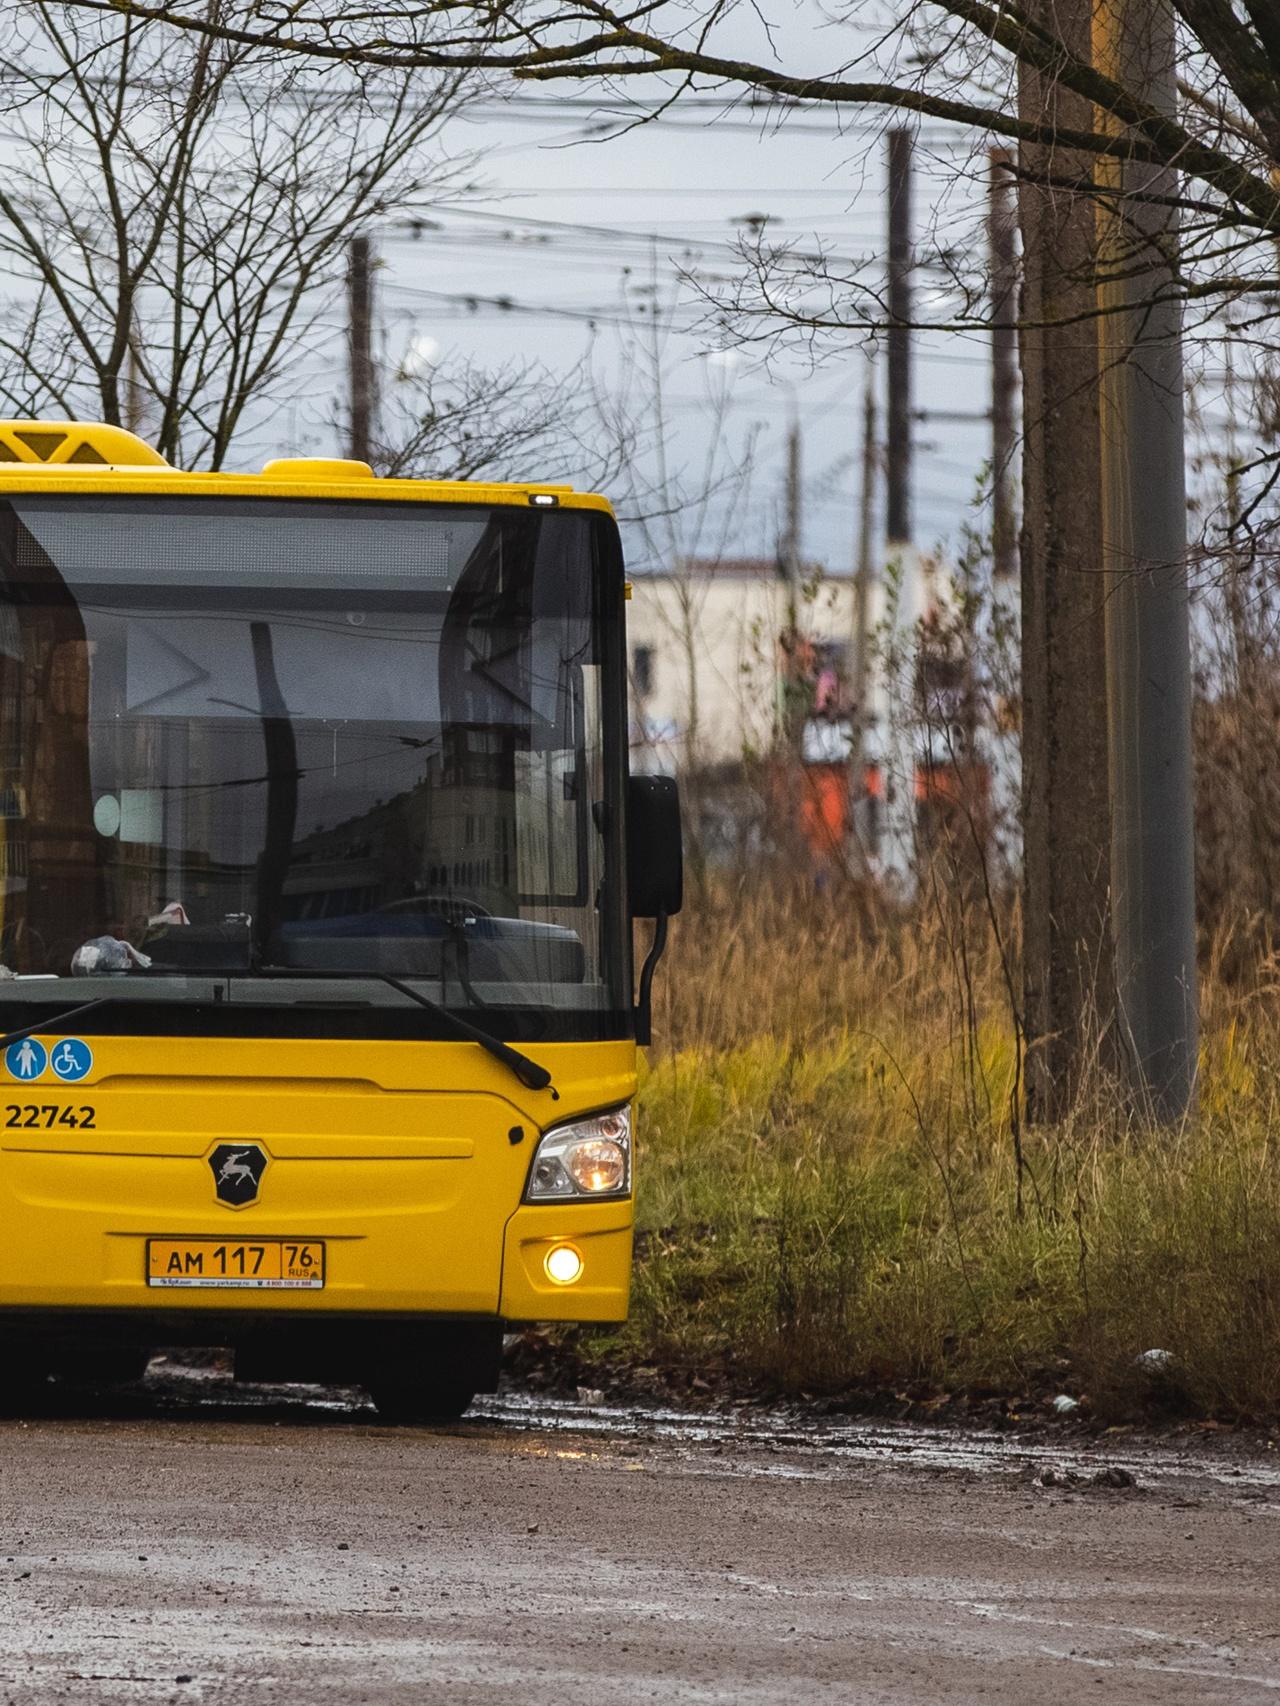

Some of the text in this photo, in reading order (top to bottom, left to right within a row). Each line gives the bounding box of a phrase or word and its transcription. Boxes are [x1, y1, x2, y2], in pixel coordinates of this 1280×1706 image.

[5, 1104, 96, 1129] 22742
[213, 1246, 265, 1275] 117
[285, 1246, 313, 1268] 76
[288, 1268, 310, 1278] RUS
